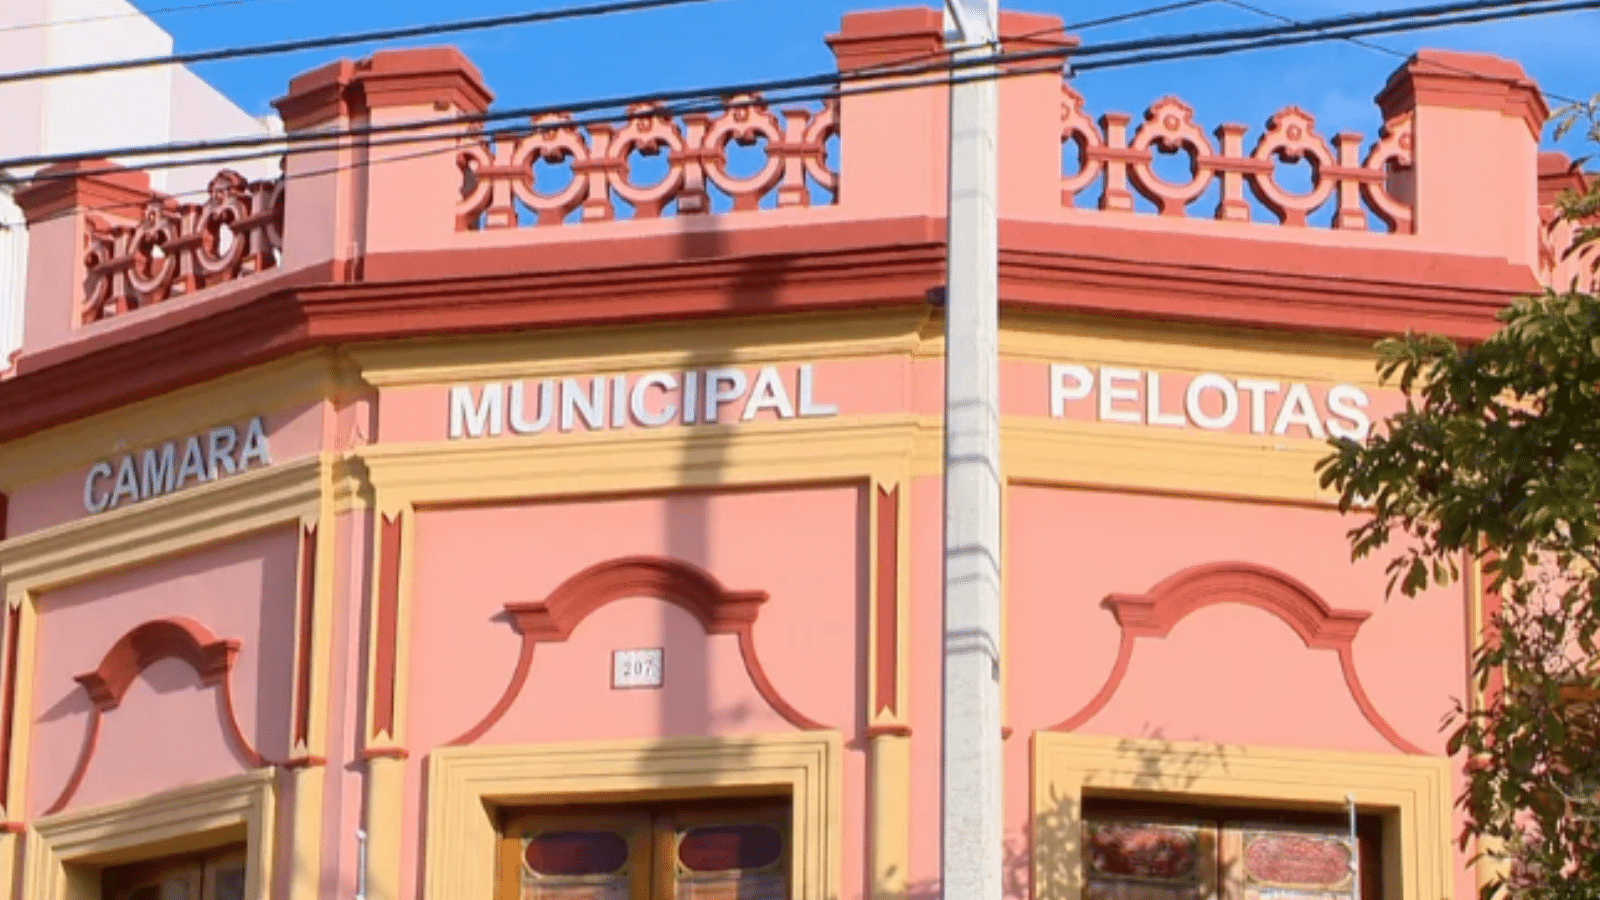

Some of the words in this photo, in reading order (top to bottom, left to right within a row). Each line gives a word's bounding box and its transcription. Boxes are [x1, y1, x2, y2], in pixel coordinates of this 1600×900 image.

[449, 364, 838, 438] MUNICIPAL
[1049, 363, 1371, 441] PELOTAS
[623, 660, 652, 677] 207
